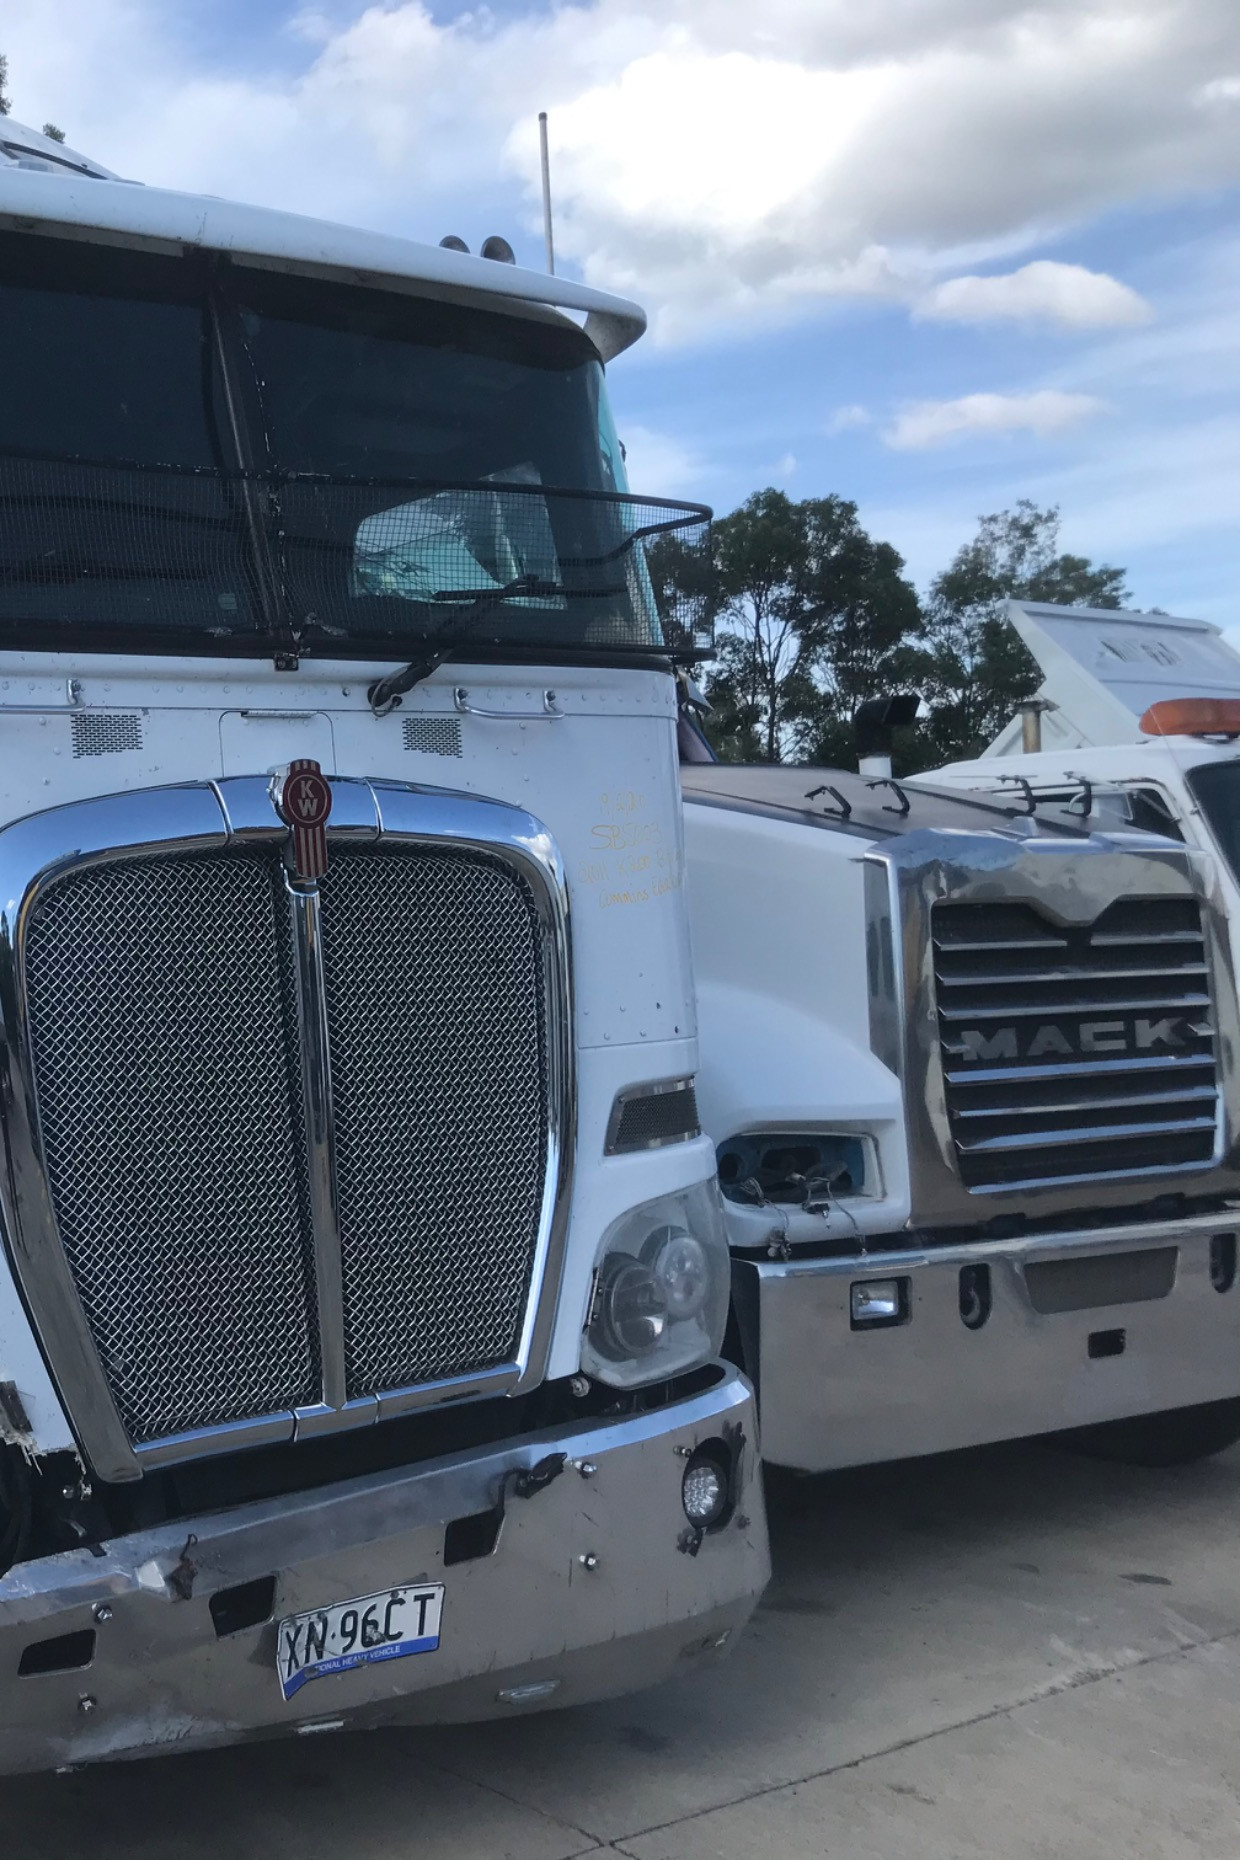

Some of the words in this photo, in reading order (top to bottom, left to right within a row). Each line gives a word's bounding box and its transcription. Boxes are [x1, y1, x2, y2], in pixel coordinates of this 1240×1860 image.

[961, 1017, 1186, 1061] MACK
[342, 1653, 369, 1666] HEAVY
[370, 1645, 401, 1659] VEHICLE
